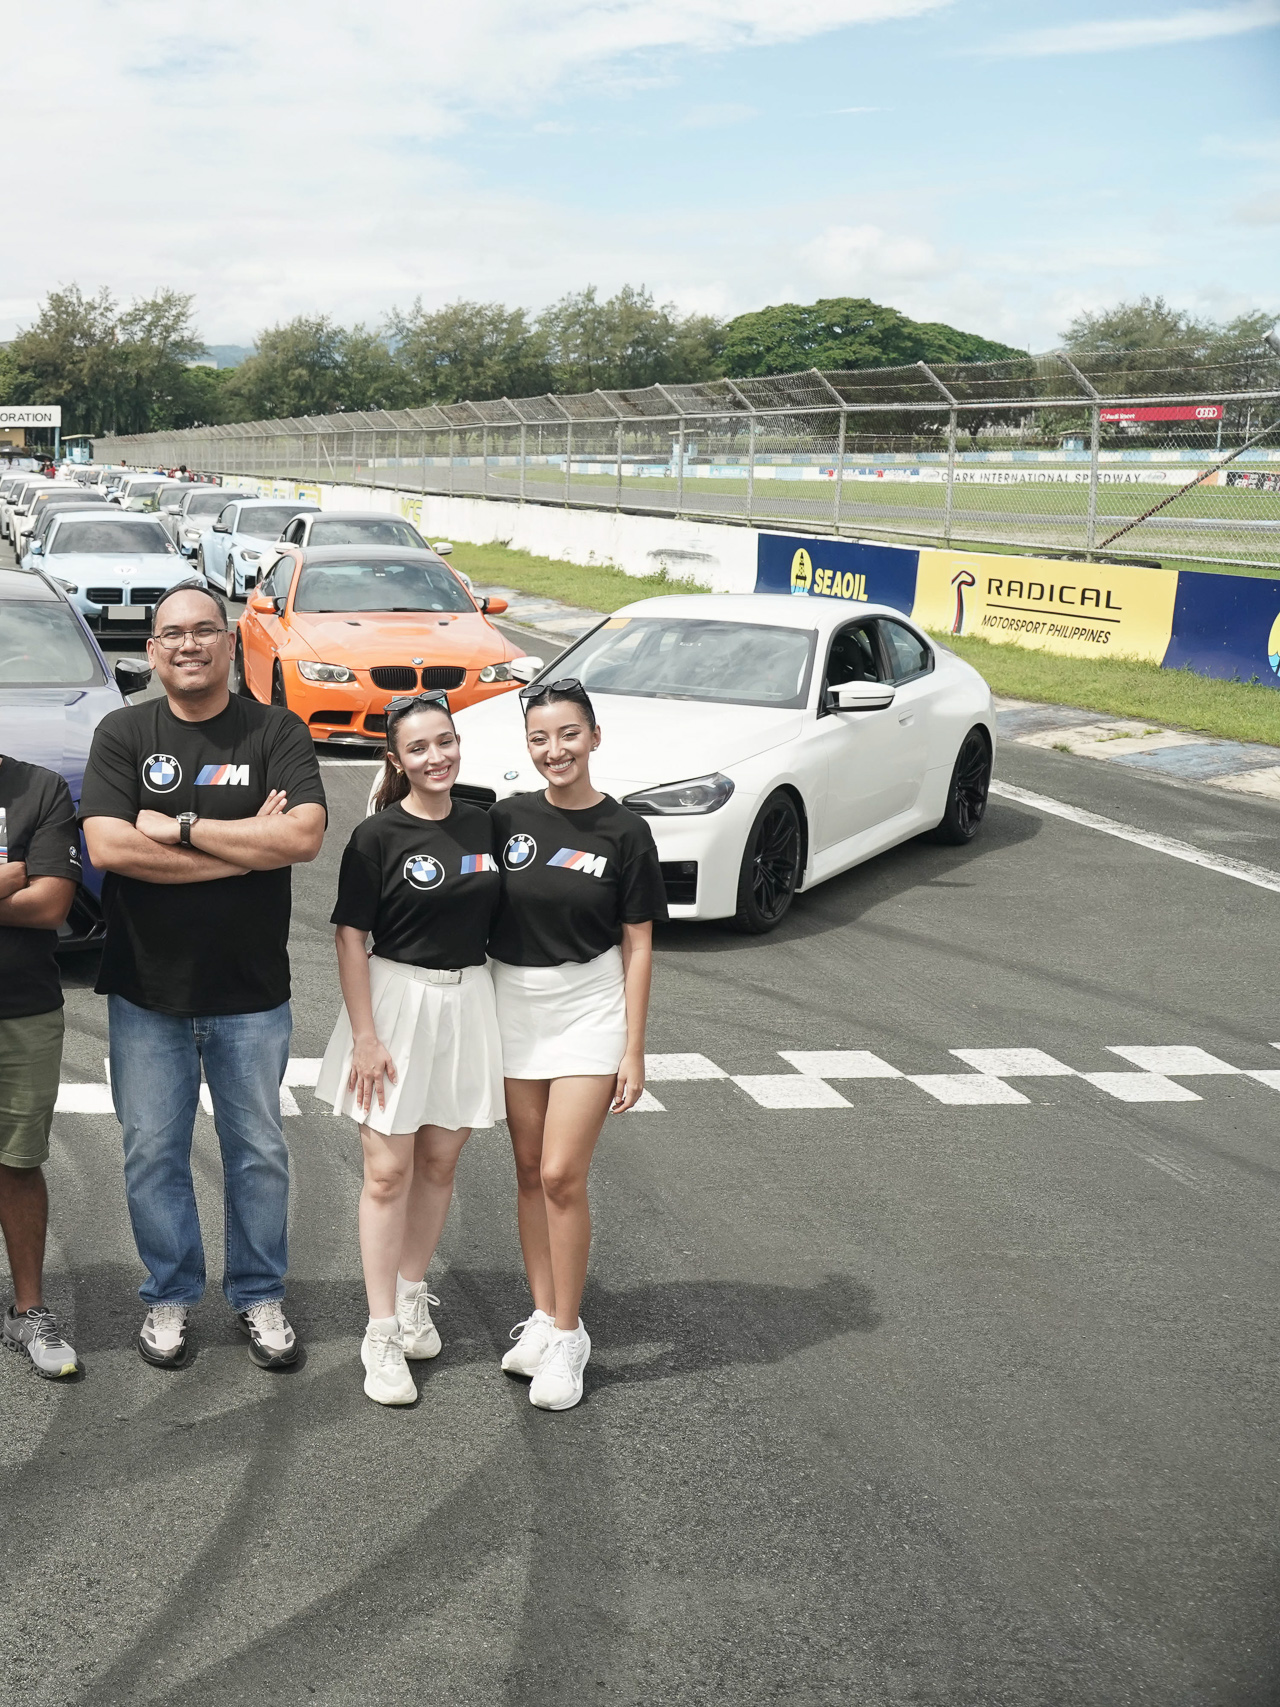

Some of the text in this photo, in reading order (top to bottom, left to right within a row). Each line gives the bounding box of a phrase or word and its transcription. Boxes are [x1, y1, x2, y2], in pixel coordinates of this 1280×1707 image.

[941, 471, 976, 482] CARK
[980, 472, 1069, 483] INTERNATIONAL
[1074, 473, 1141, 483] SPEDWAY
[814, 568, 869, 602] SEAOIL
[987, 578, 1123, 610] RADICAL
[981, 614, 1112, 645] MOTORSPORT PHILIPPINES
